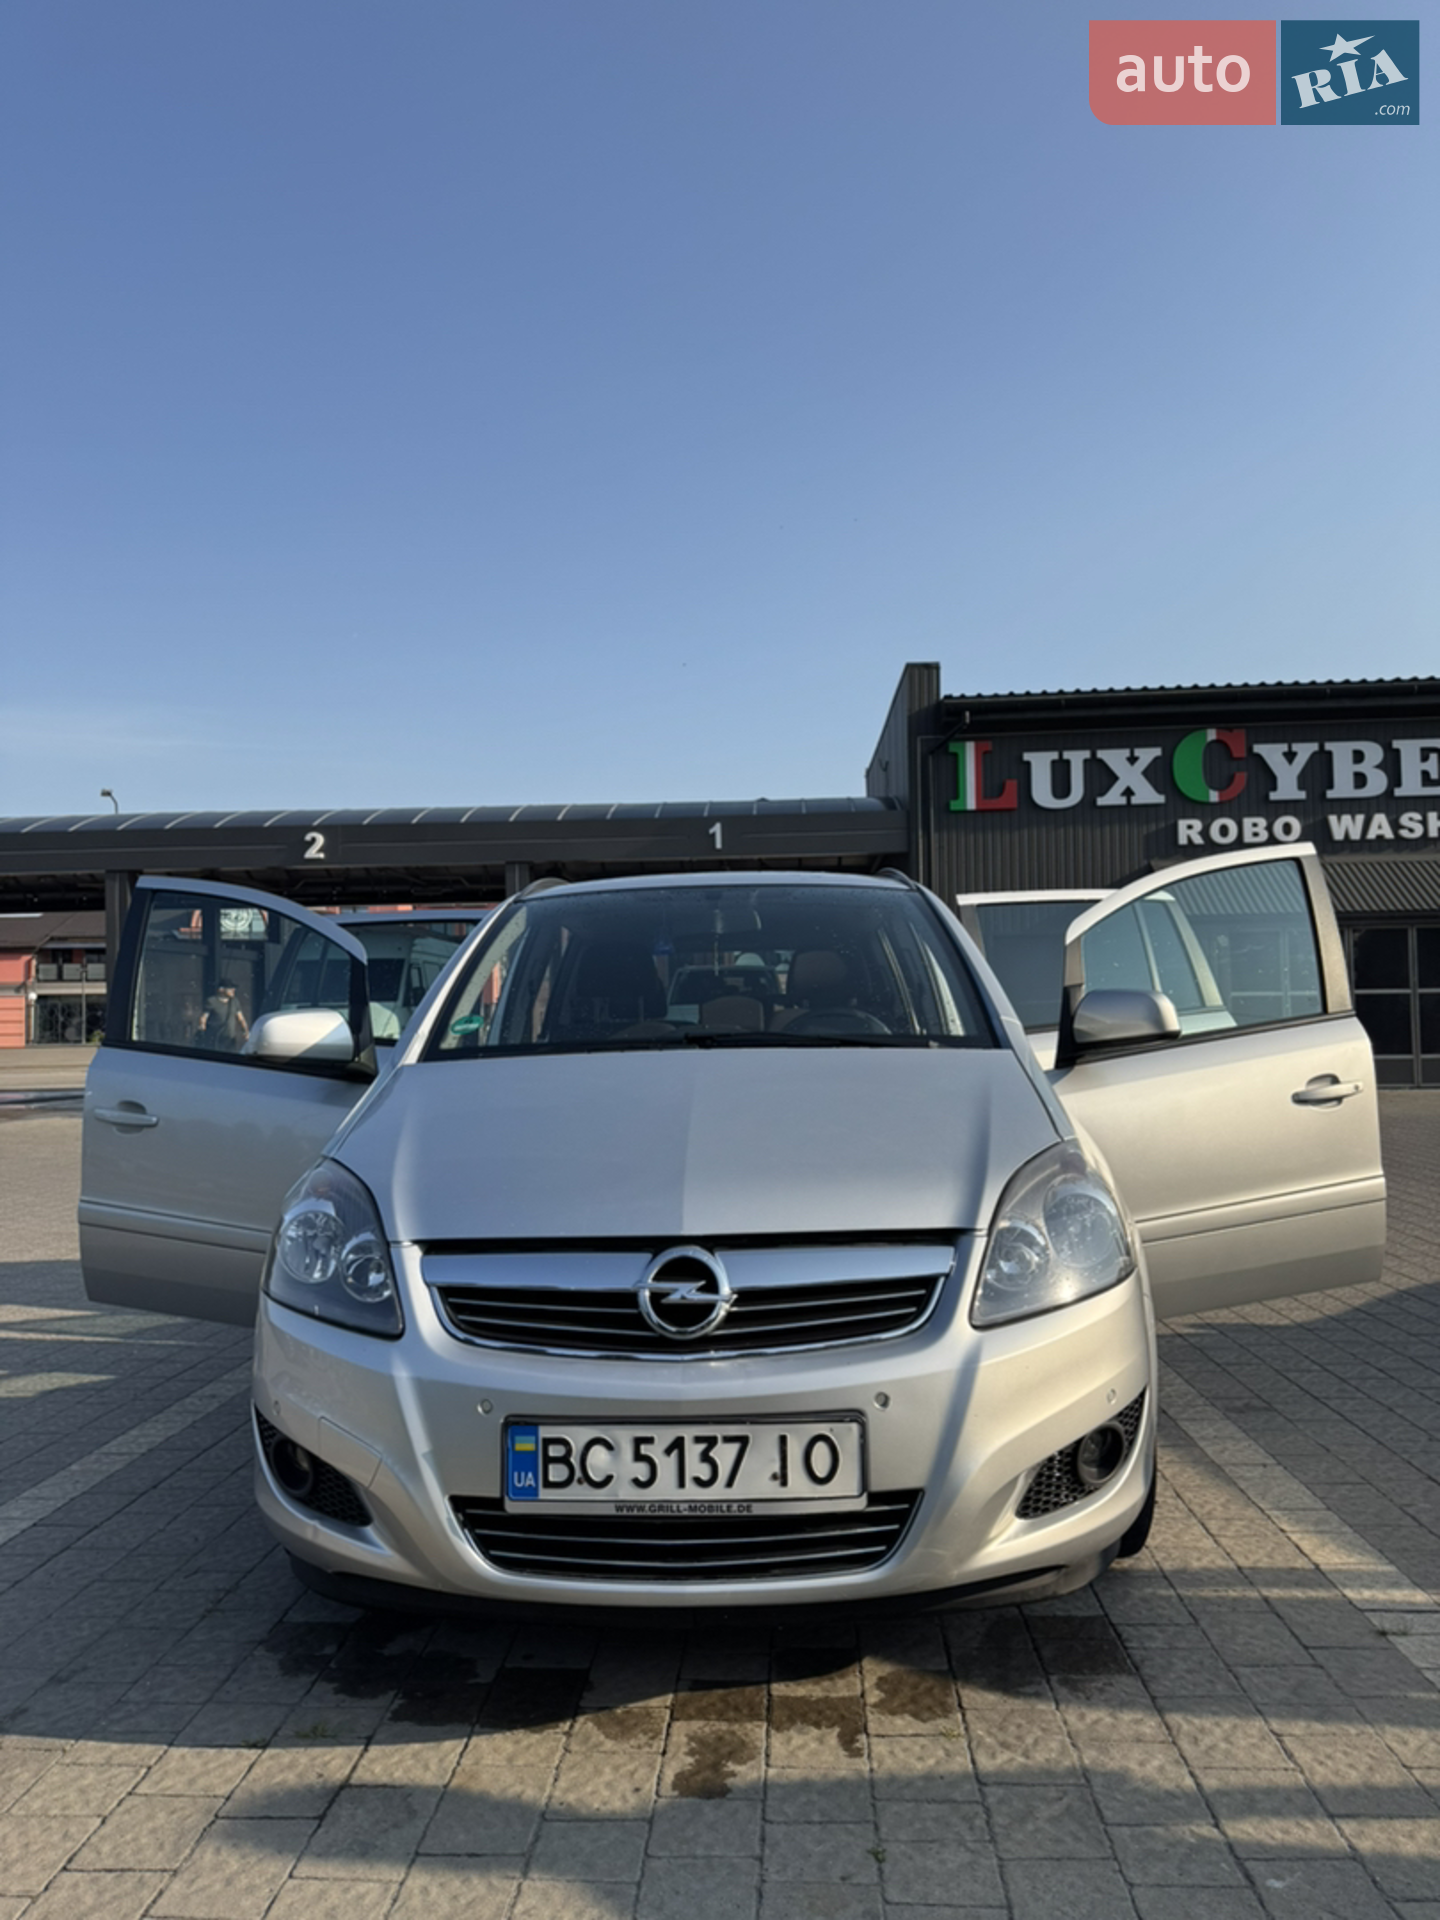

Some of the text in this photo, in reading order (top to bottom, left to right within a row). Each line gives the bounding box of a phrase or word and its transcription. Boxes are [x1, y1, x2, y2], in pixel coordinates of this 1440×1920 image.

[709, 821, 722, 849] 1
[1177, 815, 1301, 846] ROBO
[304, 831, 325, 859] 2
[541, 1433, 840, 1489] BC 5137 IO
[513, 1471, 536, 1488] UA
[614, 1502, 754, 1515] WWW.GRILL-MOBILE.DE
